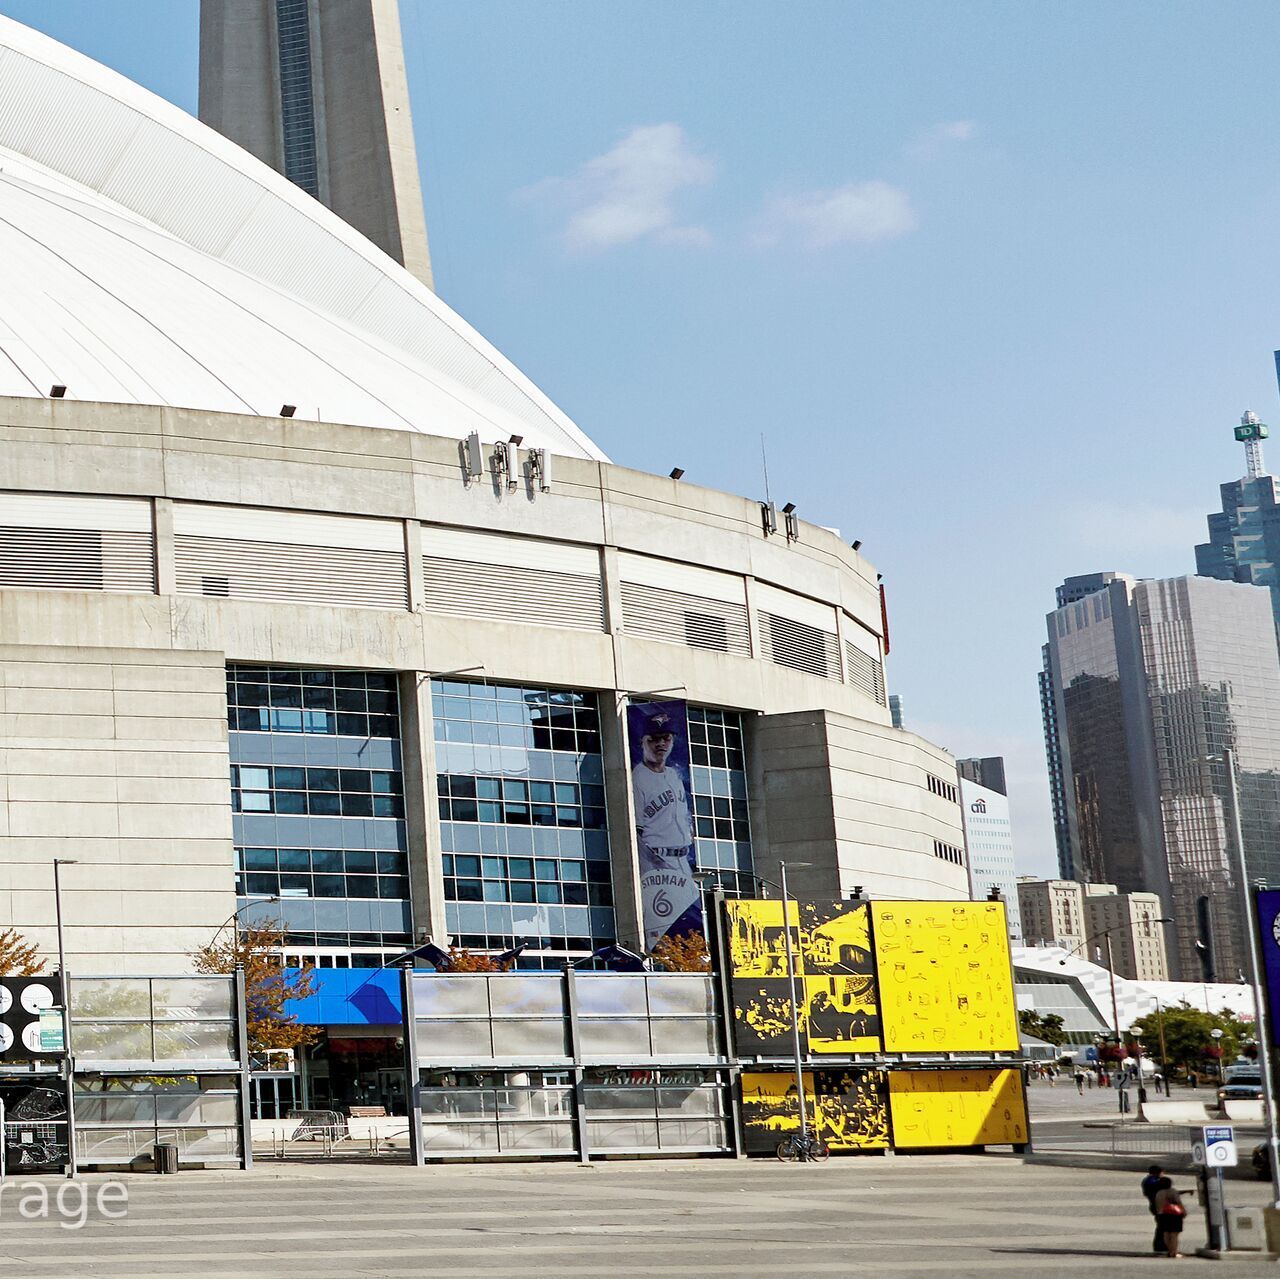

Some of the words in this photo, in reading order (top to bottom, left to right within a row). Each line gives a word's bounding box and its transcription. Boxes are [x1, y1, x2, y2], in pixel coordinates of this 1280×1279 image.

[1238, 427, 1252, 436] TD
[643, 789, 675, 818] BLUE
[970, 799, 987, 814] citi
[641, 874, 687, 890] STROMAN
[652, 888, 673, 918] 6
